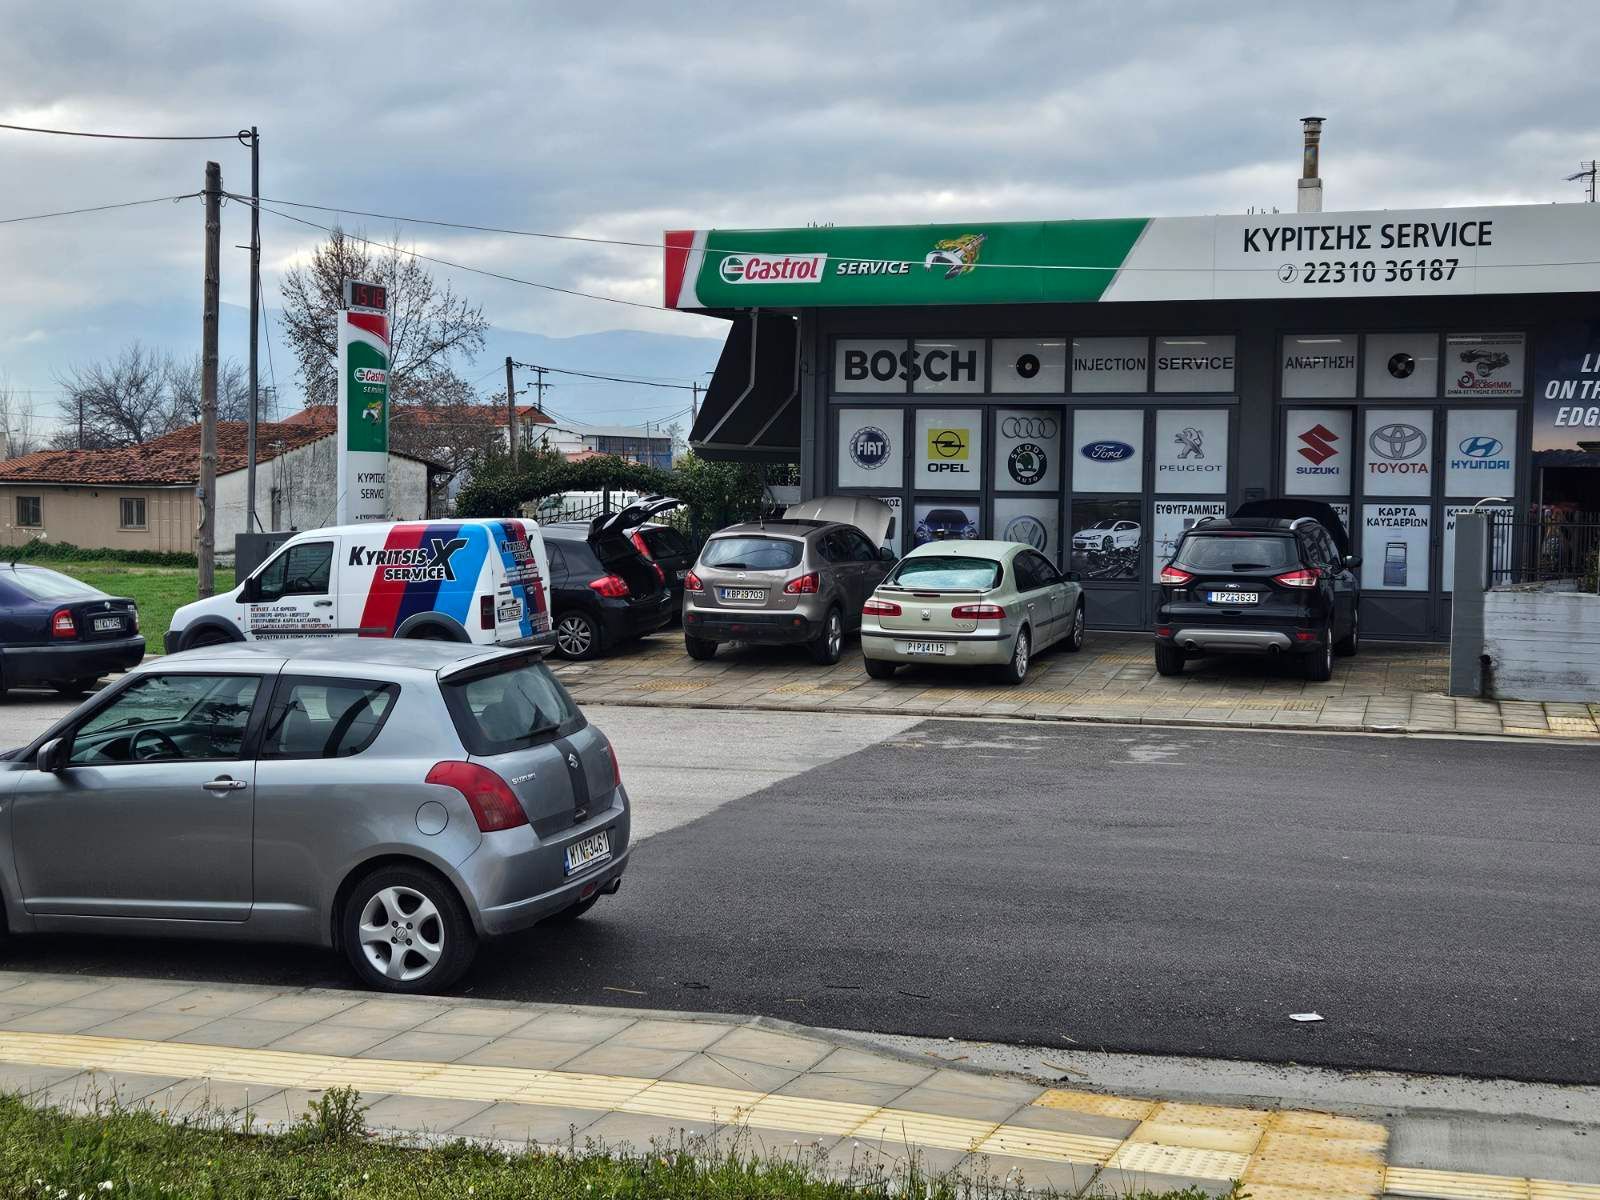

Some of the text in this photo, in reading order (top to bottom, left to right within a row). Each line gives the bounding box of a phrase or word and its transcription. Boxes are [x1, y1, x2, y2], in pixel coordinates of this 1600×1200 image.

[1244, 220, 1493, 253] ΚΥΡΙΤΣΗΣ SERVICE
[744, 256, 910, 281] Castrol SERVICE
[1303, 258, 1459, 283] 22310 36187
[844, 349, 977, 382] BOSCH
[1074, 357, 1146, 371] INJECTION
[1158, 356, 1233, 370] SERVICE
[1284, 355, 1355, 369] ΑΝΑΡΤΗΣΗ
[1545, 379, 1578, 399] ON
[1554, 406, 1600, 427] EDG
[856, 441, 884, 456] FIAT
[1011, 444, 1045, 460] SKODA
[1091, 444, 1124, 459] Ford
[927, 463, 970, 473] OPEL
[1159, 464, 1223, 472] PEUGEOT
[1296, 467, 1340, 475] SUZUKI
[1368, 462, 1429, 474] TOYOTA
[1451, 460, 1510, 470] HYUNDAI
[1156, 504, 1225, 515] ΕΥΘΥΓΡΑΜΜΙΣΗ
[1378, 507, 1417, 517] ΚΑΡΤΑ
[1366, 518, 1428, 527] ΚΑΥΣΑΕΡΙΩΝ
[384, 567, 444, 581] SERVICE
